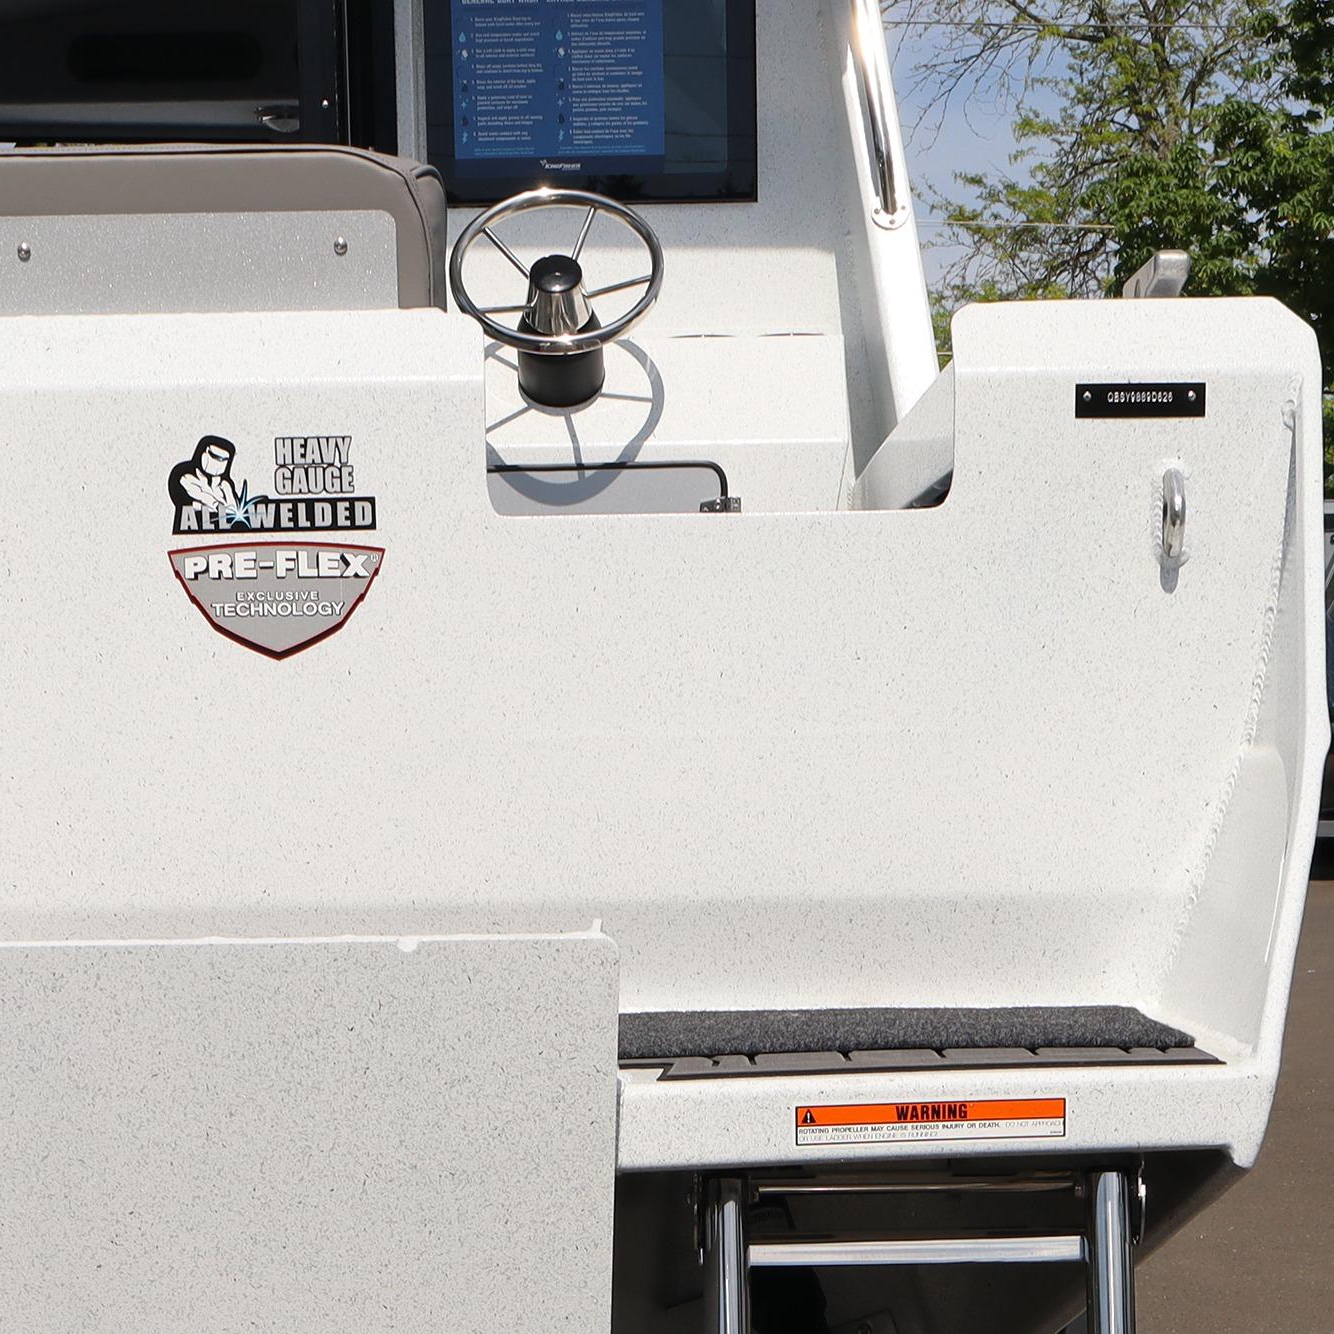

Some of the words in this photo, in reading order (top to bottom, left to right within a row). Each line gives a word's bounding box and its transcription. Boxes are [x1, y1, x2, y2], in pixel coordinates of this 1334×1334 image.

[274, 435, 352, 466] HEAVY
[274, 464, 354, 495] GAUGE
[179, 503, 233, 531] ALL
[247, 500, 373, 530] WELDED
[236, 591, 319, 601] EXCLUSIVE
[211, 602, 345, 617] TECHNOLOGY
[896, 1103, 968, 1121] WARNING
[798, 1127, 829, 1135] ROTATING
[831, 1126, 869, 1134] PROPELLER
[910, 1123, 939, 1131] SERIOUS
[941, 1122, 964, 1130] INJURY
